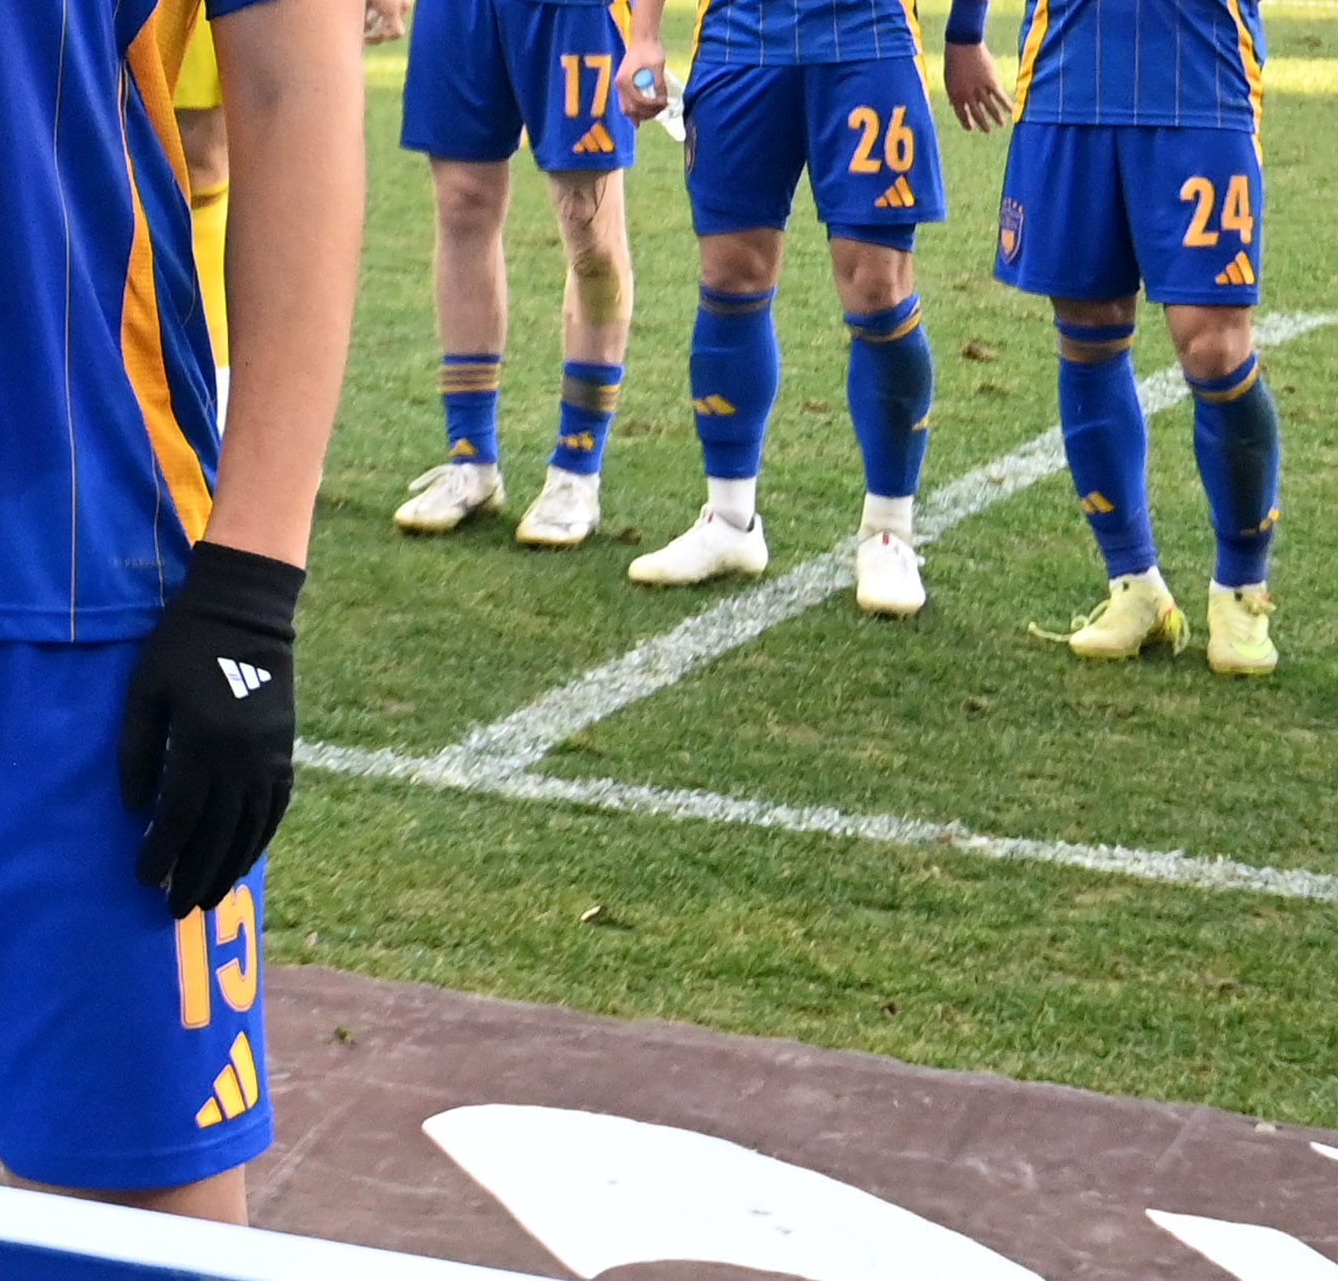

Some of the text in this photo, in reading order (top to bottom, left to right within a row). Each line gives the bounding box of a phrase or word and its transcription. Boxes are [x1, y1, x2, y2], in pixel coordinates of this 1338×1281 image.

[562, 54, 612, 117] 17
[848, 106, 915, 173] 26
[1180, 174, 1255, 247] 24
[175, 884, 258, 1029] 15
